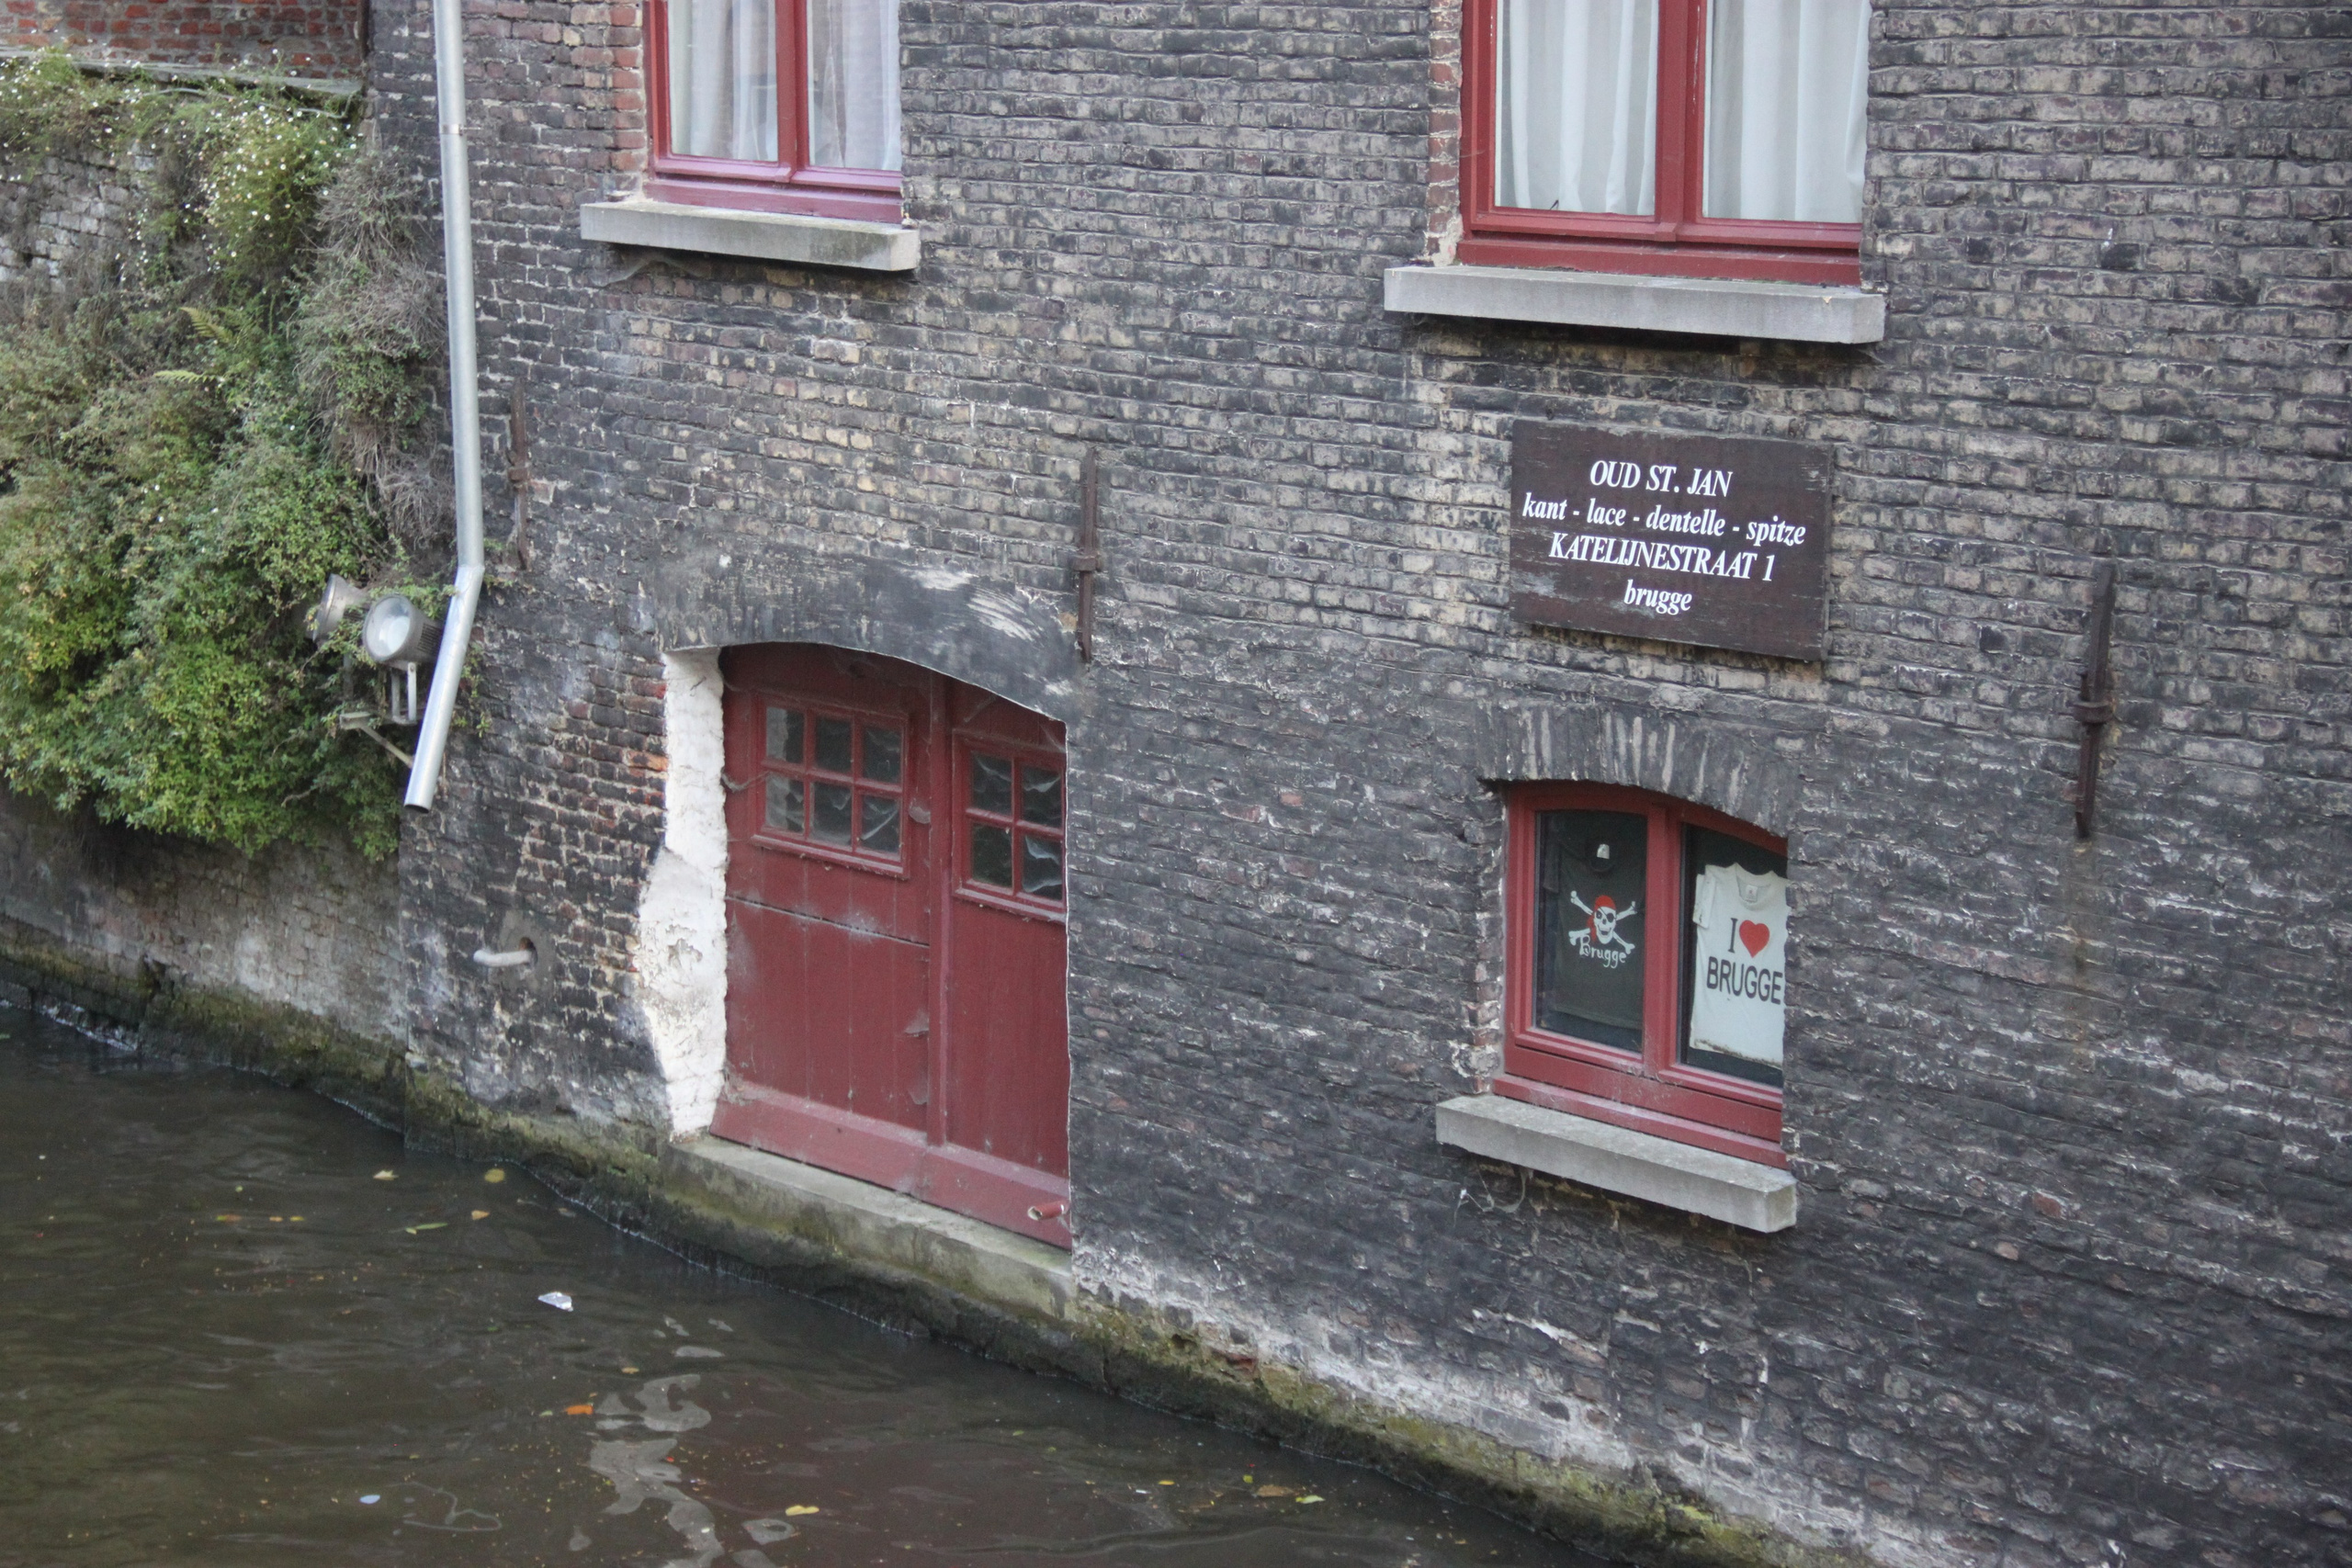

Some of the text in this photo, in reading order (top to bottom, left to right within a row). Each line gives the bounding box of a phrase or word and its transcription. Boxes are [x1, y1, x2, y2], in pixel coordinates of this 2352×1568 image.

[1590, 460, 1733, 497] OUD ST. JAN
[1522, 492, 1567, 521] kant
[1587, 498, 1626, 526] lace
[1646, 504, 1725, 536] dentelle
[1746, 515, 1806, 547] spitze
[1549, 532, 1775, 581] KATELIJNESTRAAT 1
[1624, 580, 1692, 615] brugge
[1578, 934, 1626, 969] Brugge
[1727, 918, 1738, 953] I
[1707, 956, 1783, 1005] BRUGGE
